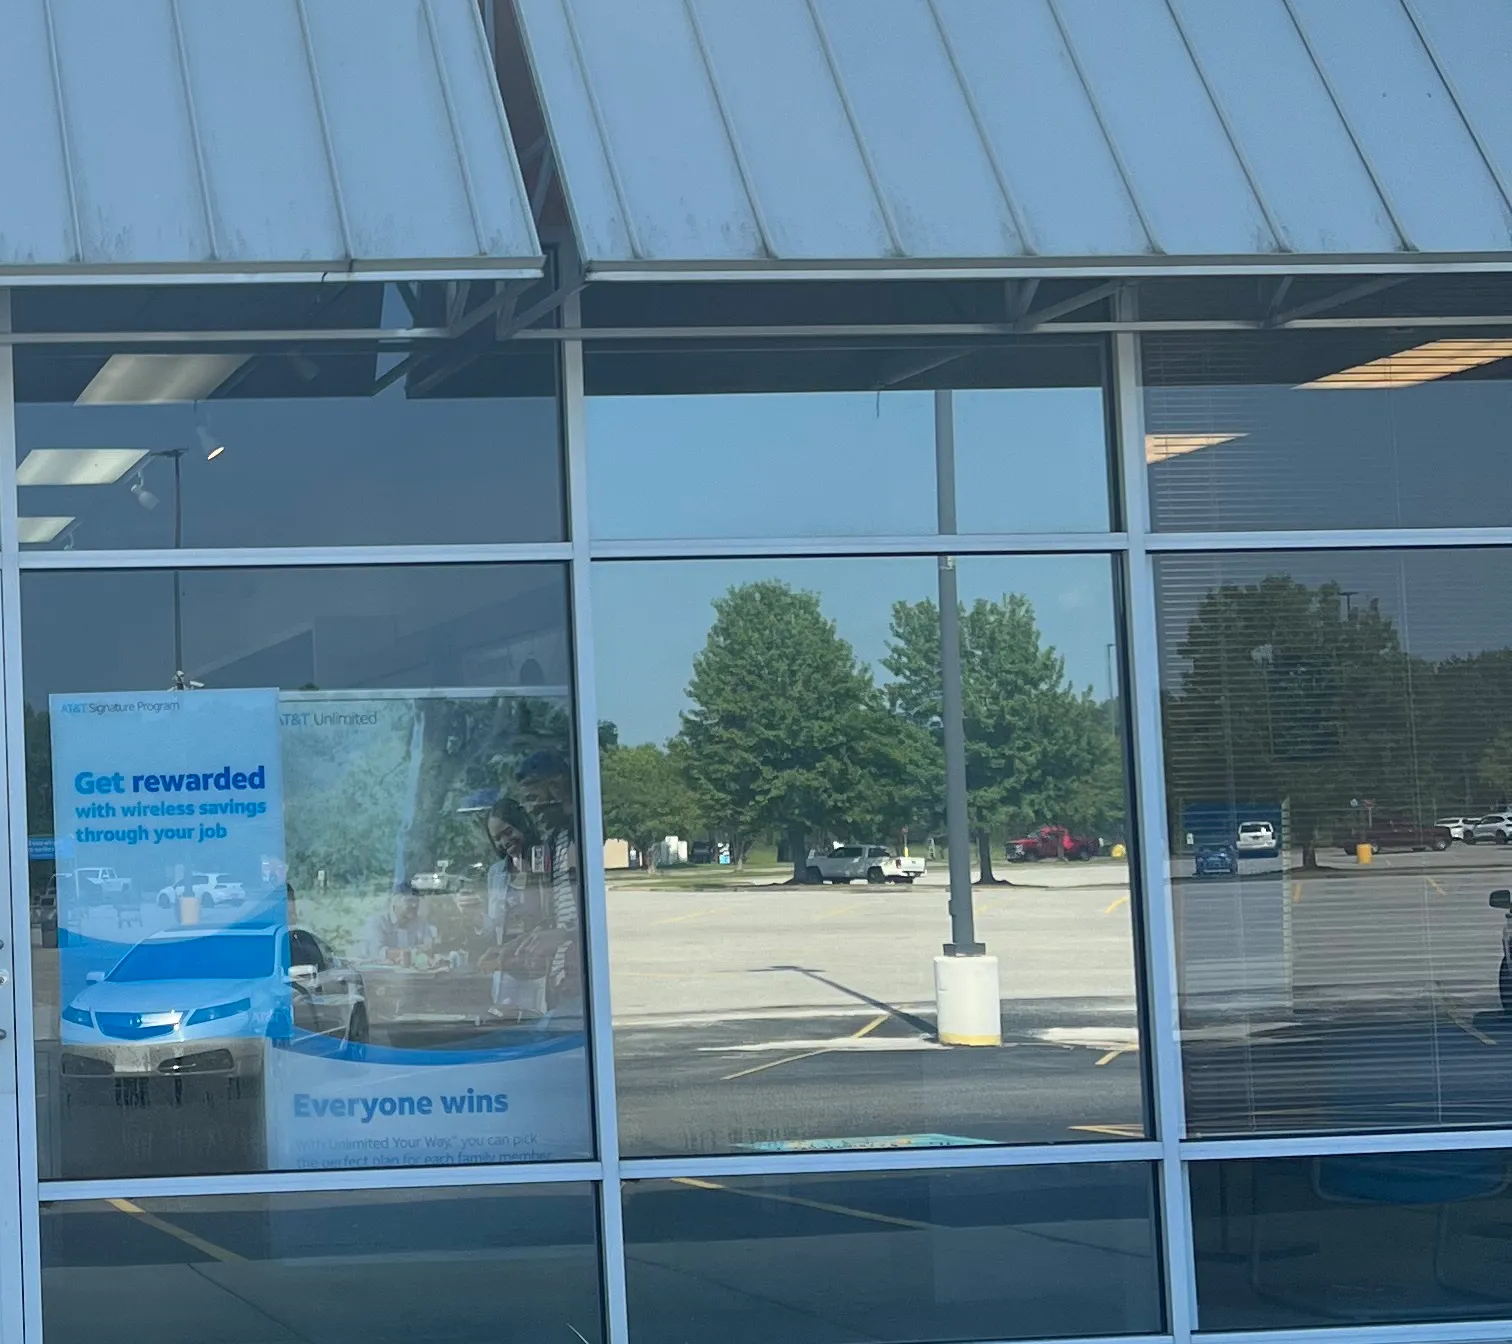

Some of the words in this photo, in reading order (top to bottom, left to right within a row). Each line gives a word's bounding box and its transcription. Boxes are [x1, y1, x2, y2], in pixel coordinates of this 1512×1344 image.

[88, 702, 135, 716] Signature
[137, 701, 180, 713] Program
[314, 711, 377, 726] Unlimited
[74, 771, 125, 794] Get
[132, 765, 266, 793] rewarded
[75, 802, 116, 818] with
[119, 800, 195, 817] wireless
[199, 799, 267, 818] savings
[75, 824, 149, 845] through
[153, 827, 195, 844] your
[197, 822, 228, 843] job
[293, 1092, 433, 1123] Everyone
[440, 1088, 509, 1114] wins
[328, 1136, 389, 1151] Unlimited
[392, 1137, 420, 1149] Your
[460, 1137, 485, 1149] you
[487, 1135, 510, 1145] can
[512, 1133, 538, 1147] pick
